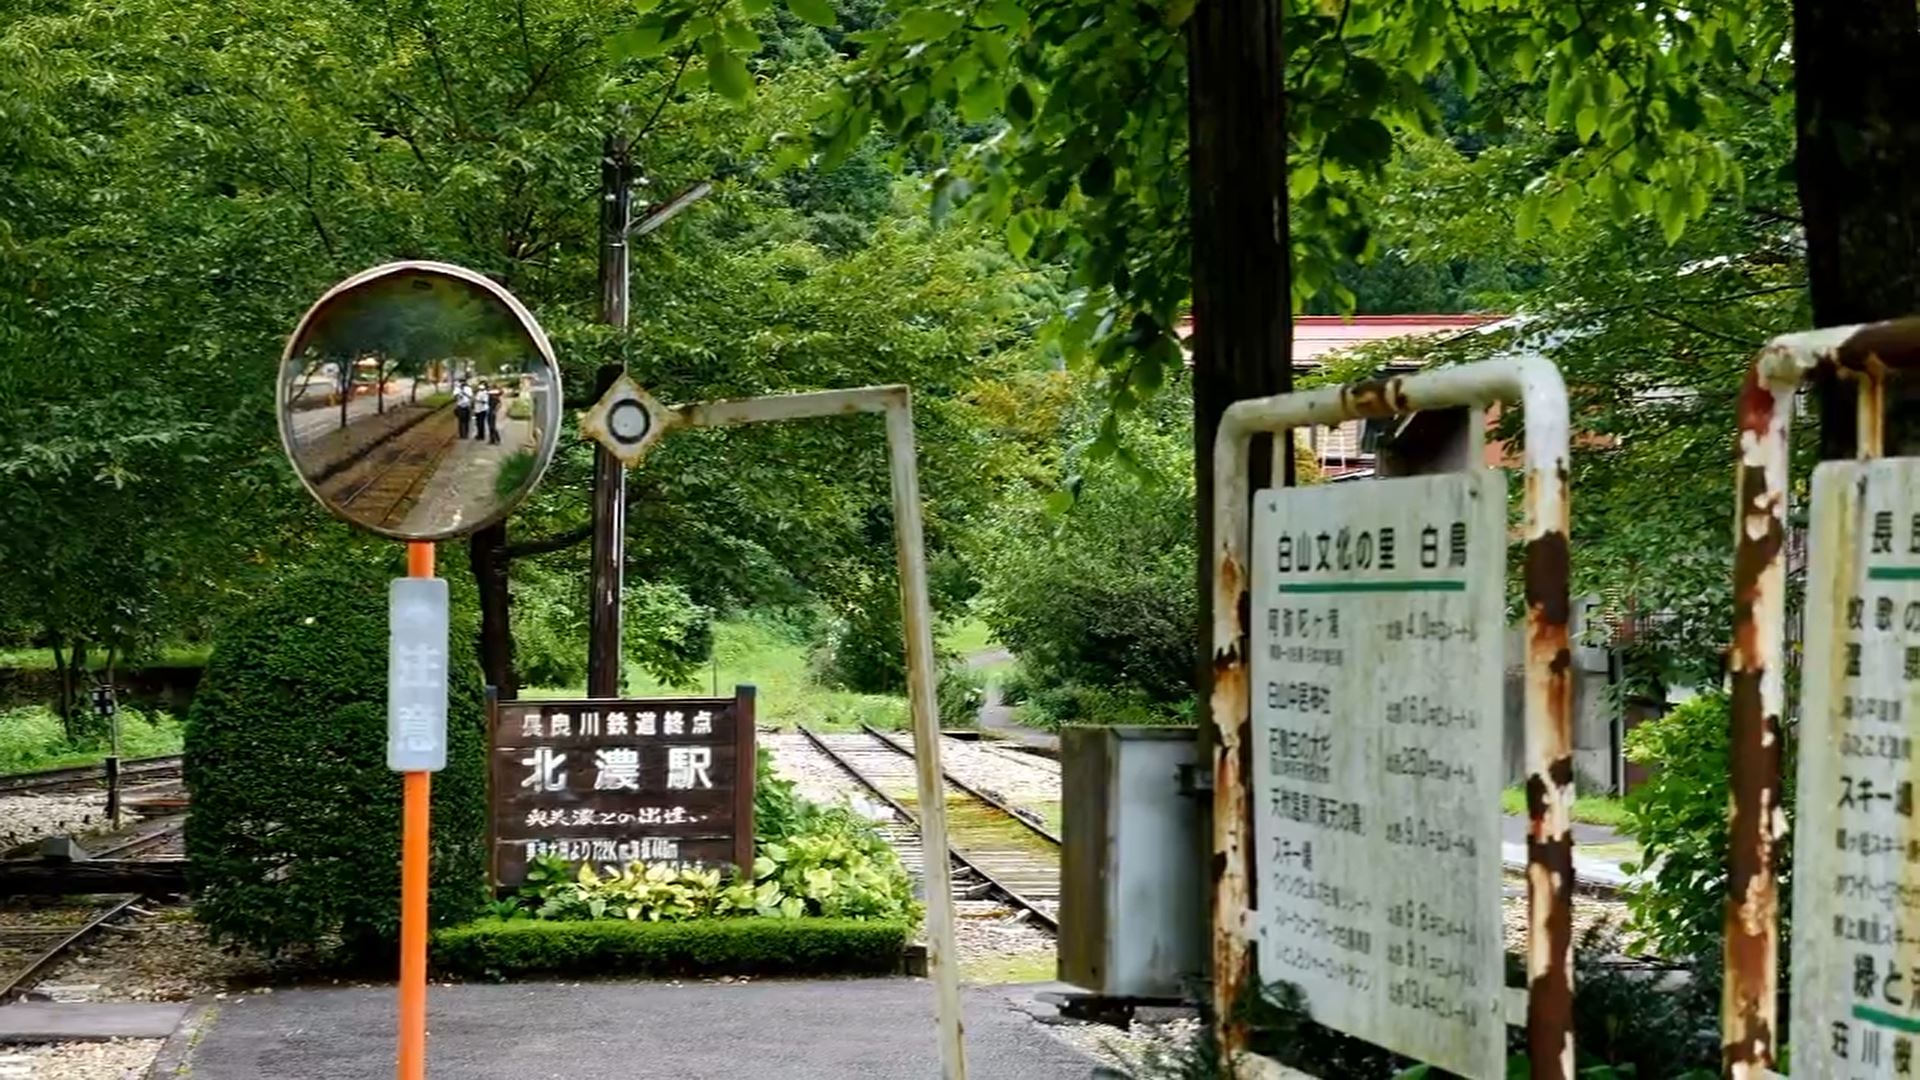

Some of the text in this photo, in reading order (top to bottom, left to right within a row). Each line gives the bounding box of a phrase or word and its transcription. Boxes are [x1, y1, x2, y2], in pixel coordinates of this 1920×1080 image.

[1277, 521, 1467, 573] 白山文化の里 白鳥
[521, 710, 713, 737] 長良川鉄道終点
[520, 746, 713, 793] 北濃駅
[1837, 776, 1913, 818] スキー場
